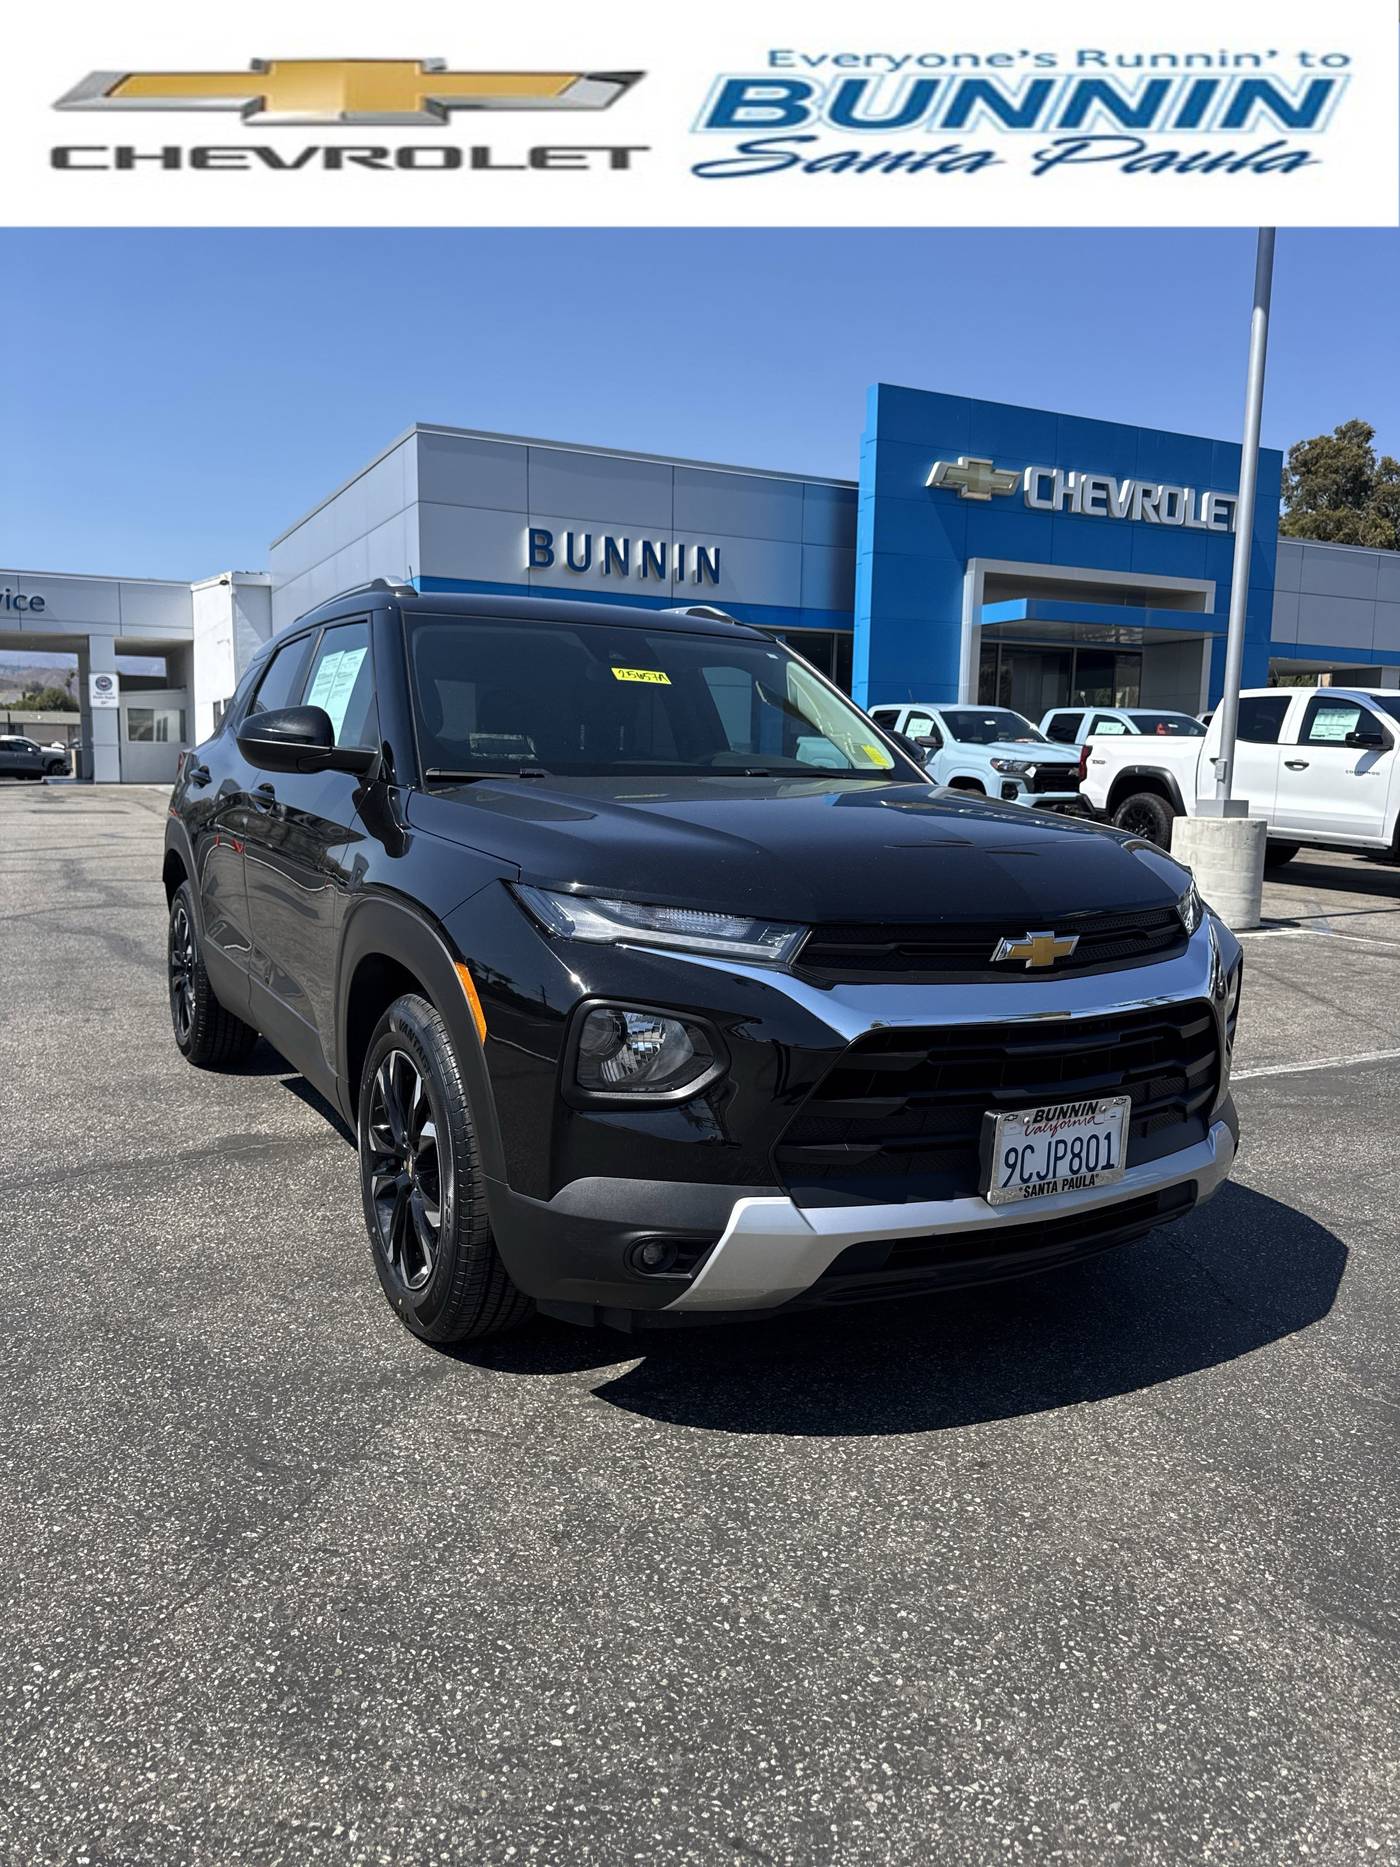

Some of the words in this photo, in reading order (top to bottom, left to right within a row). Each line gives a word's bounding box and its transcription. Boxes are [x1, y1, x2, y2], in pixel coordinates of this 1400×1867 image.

[526, 527, 721, 585] BUNNIN
[1032, 1101, 1099, 1124] BUNNIN
[1002, 1132, 1115, 1188] 9CJP801
[1023, 1180, 1058, 1198] SANTA
[1061, 1174, 1095, 1191] PAULA
